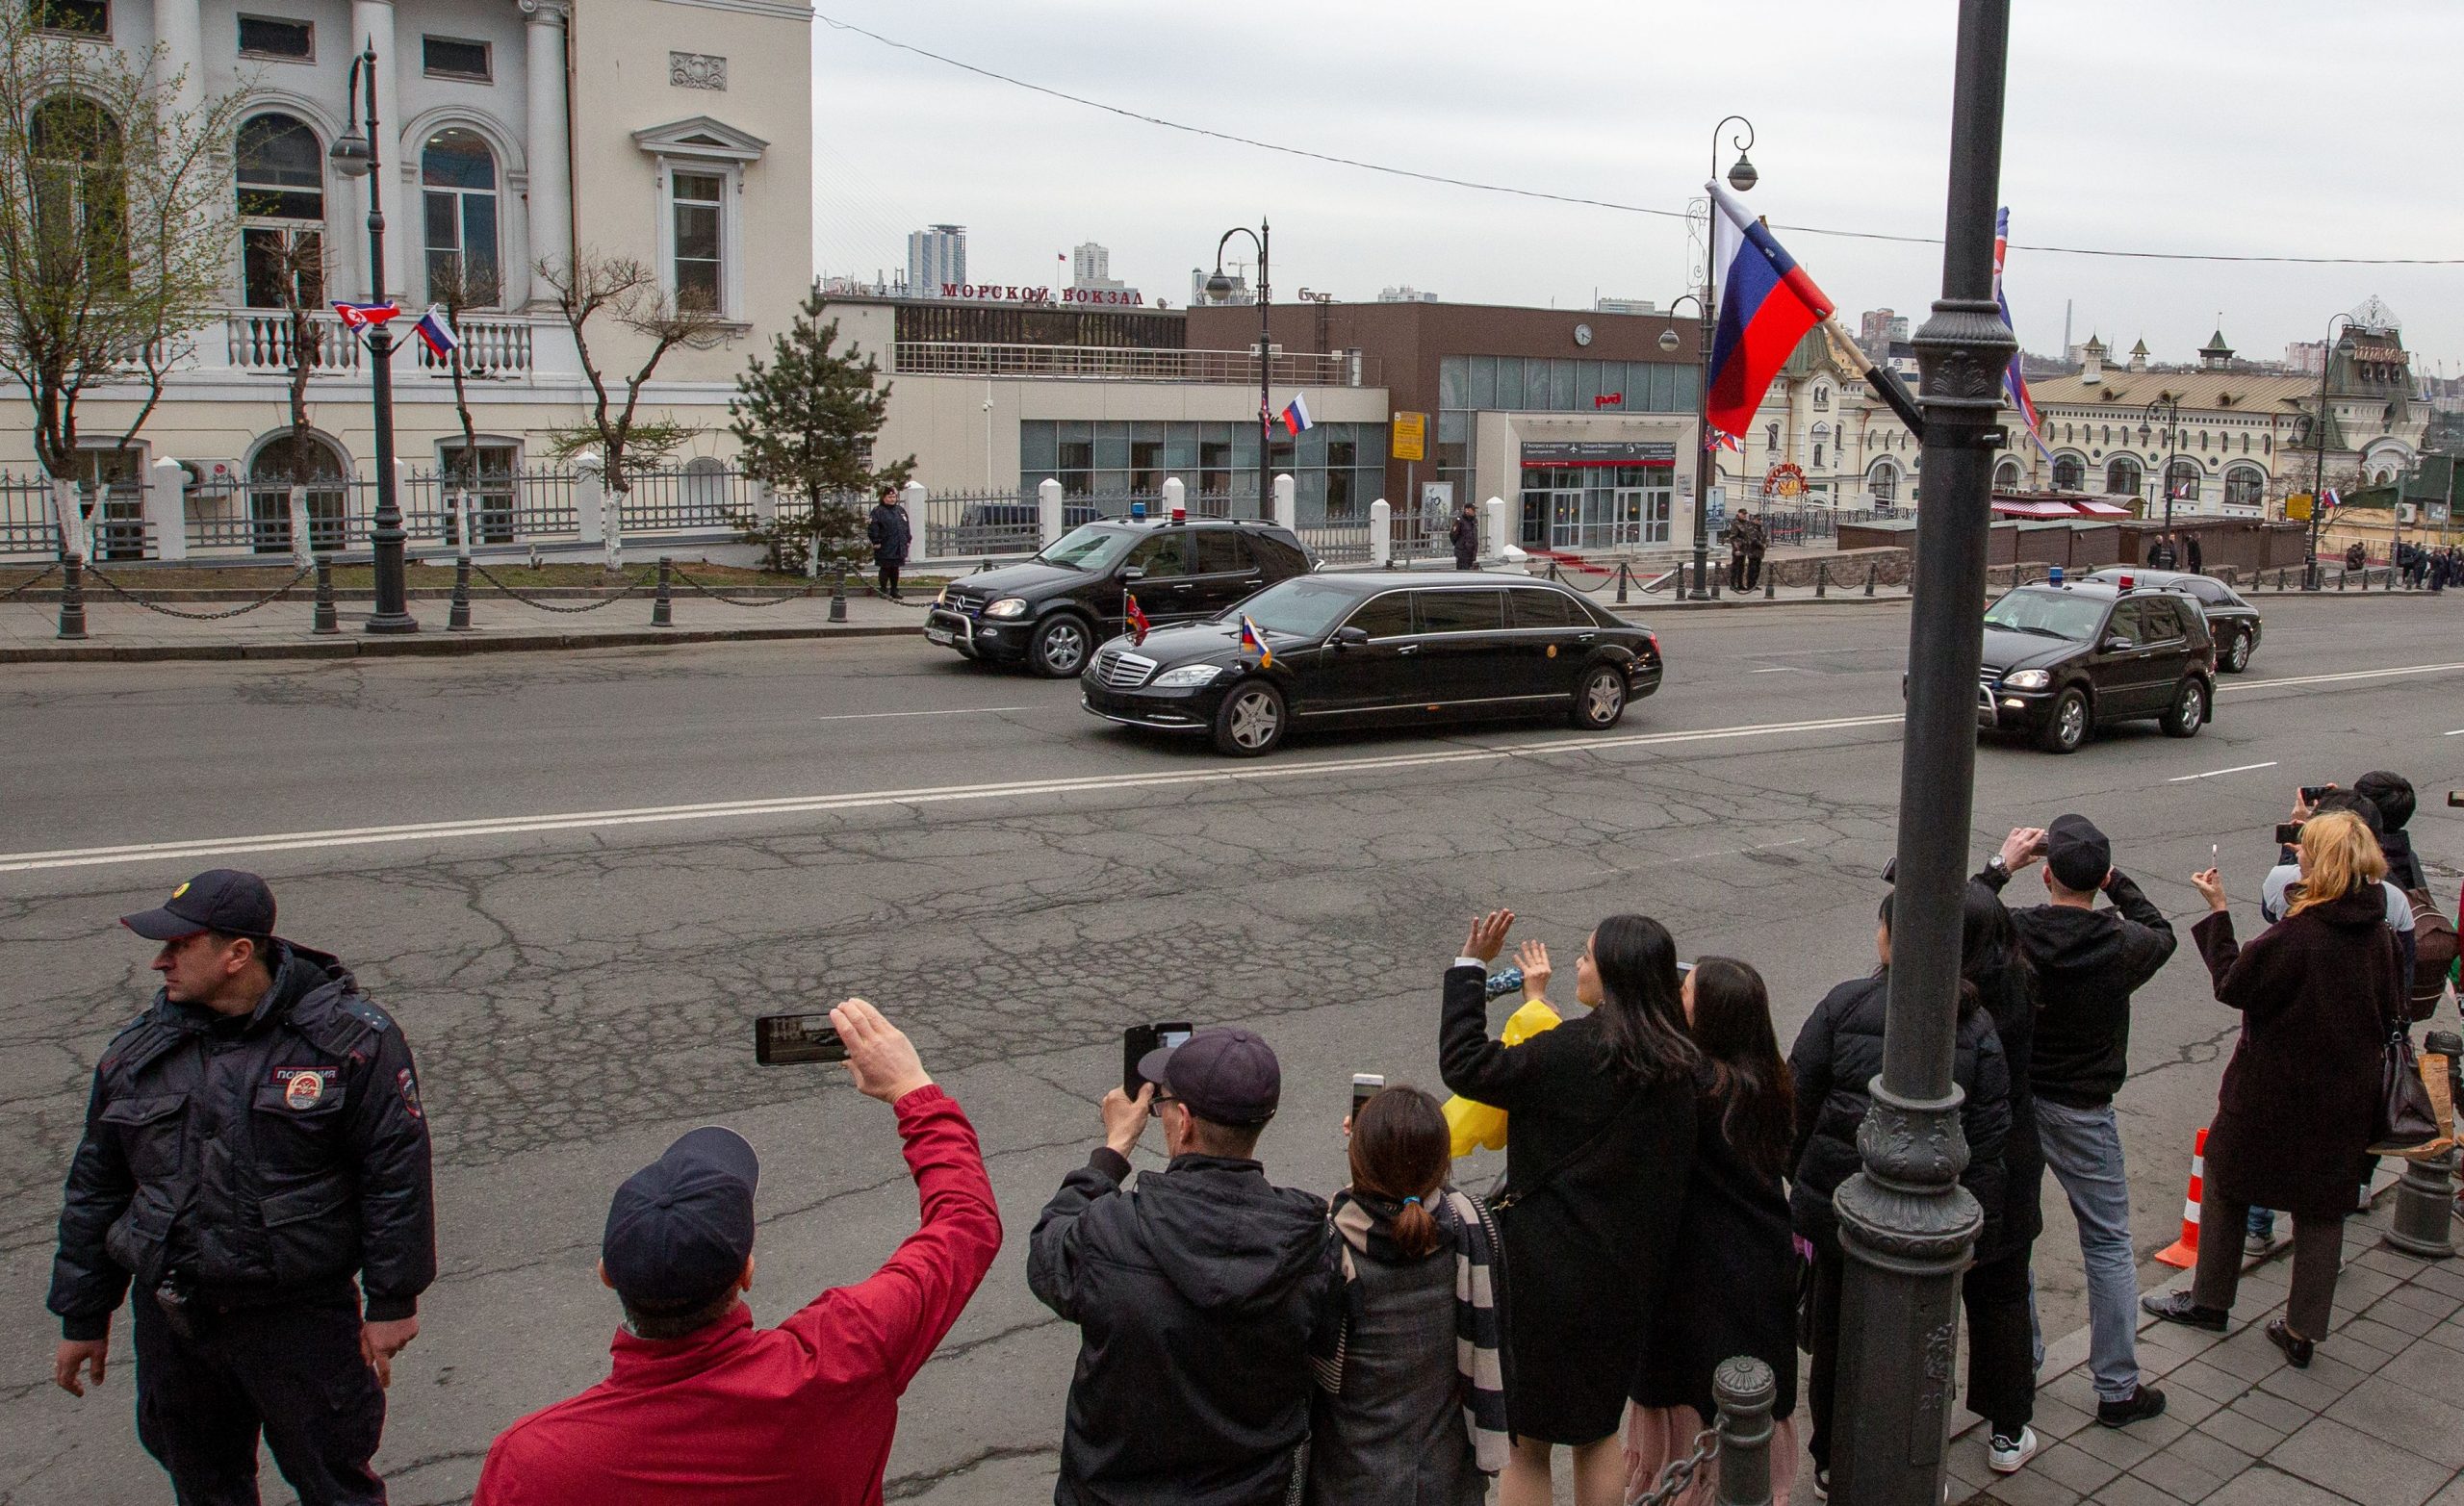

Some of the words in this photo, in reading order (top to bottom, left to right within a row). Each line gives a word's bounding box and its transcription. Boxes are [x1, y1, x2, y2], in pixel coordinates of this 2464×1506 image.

[941, 283, 1049, 303] МОРСКОЙ
[1062, 288, 1143, 305] ВОКЗАЛ
[277, 1070, 336, 1079] ПОИЯ
